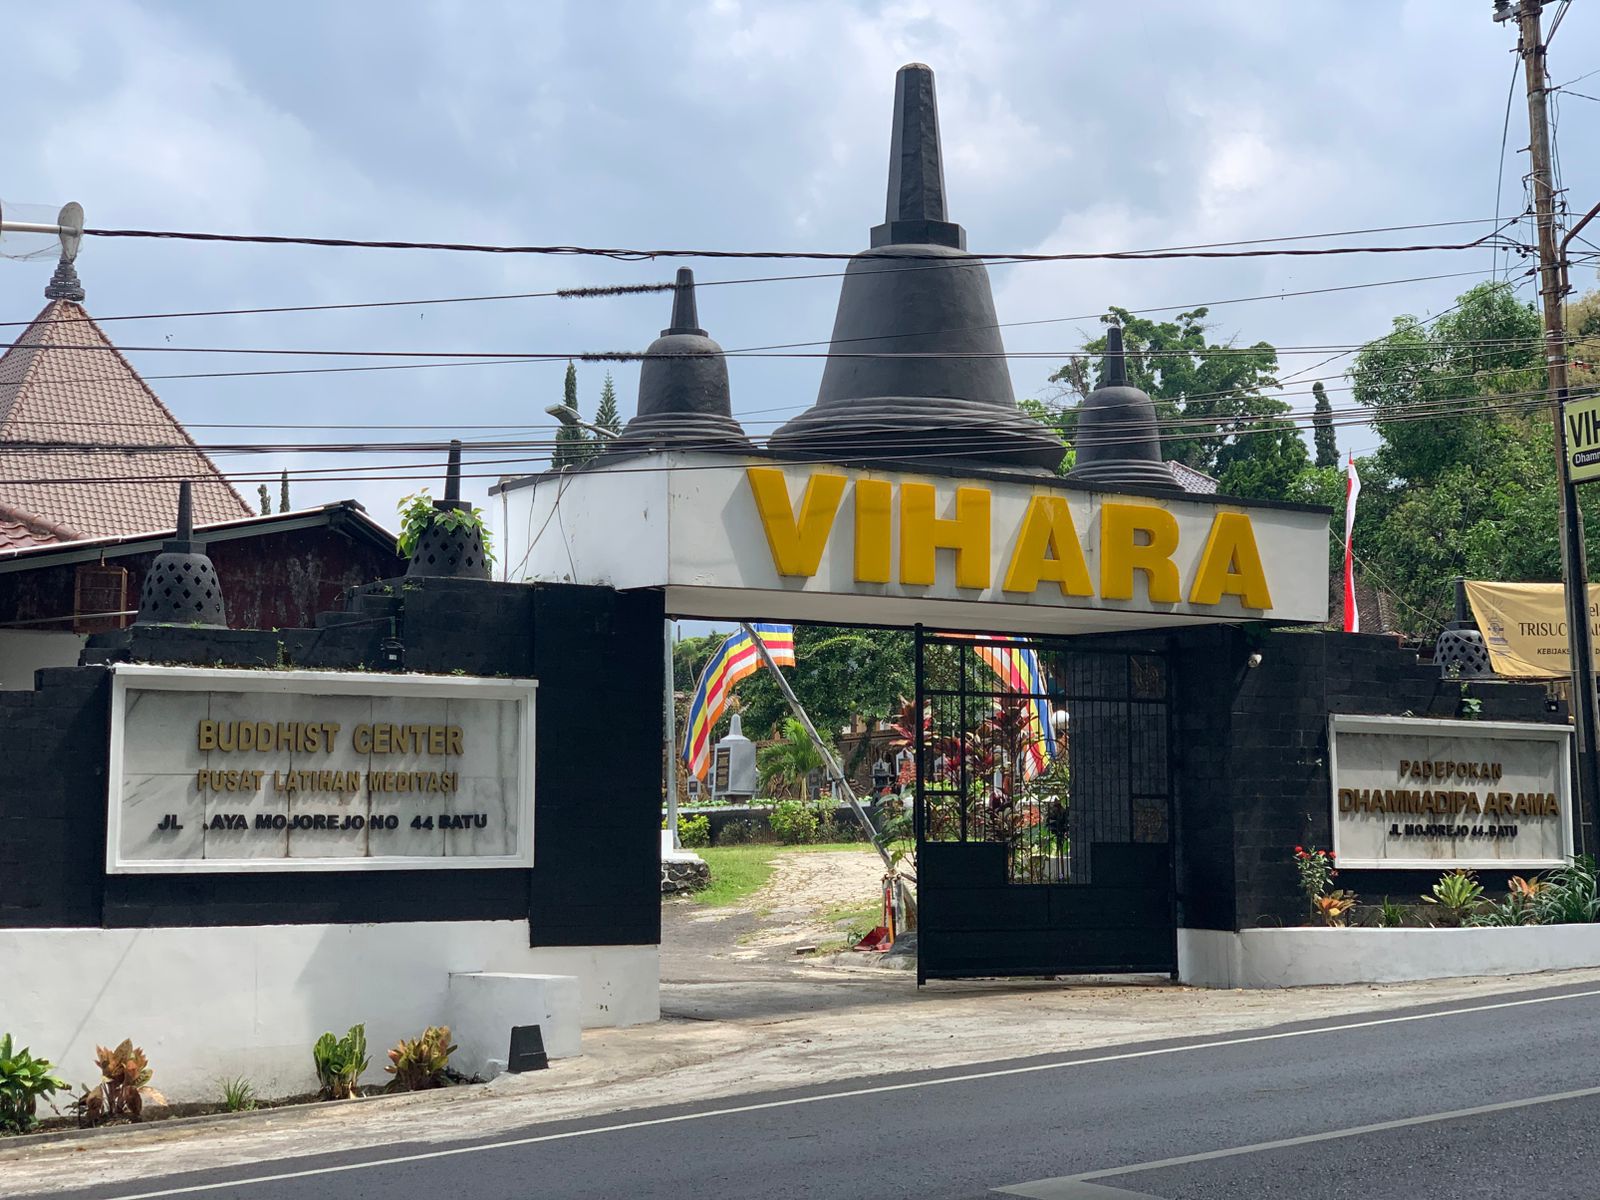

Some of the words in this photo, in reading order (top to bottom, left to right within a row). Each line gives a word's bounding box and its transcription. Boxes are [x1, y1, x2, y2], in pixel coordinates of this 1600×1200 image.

[747, 467, 1273, 610] VIHARA
[198, 720, 341, 753] BUDDHIST
[353, 724, 464, 755] CENTER
[197, 769, 264, 792] PUSAT
[273, 769, 360, 793] LATIHAN
[367, 771, 459, 794] MEDITASI
[1400, 760, 1502, 780] PADEPOKAN
[1338, 788, 1482, 814] DHAMMADIPA
[1483, 792, 1561, 817] ARAMA
[157, 814, 184, 830] JL
[255, 814, 365, 830] MOJOREJO
[370, 815, 399, 830] NO
[410, 815, 434, 830] 44
[438, 814, 487, 830] BATU
[1404, 824, 1469, 837] MOJOREJO
